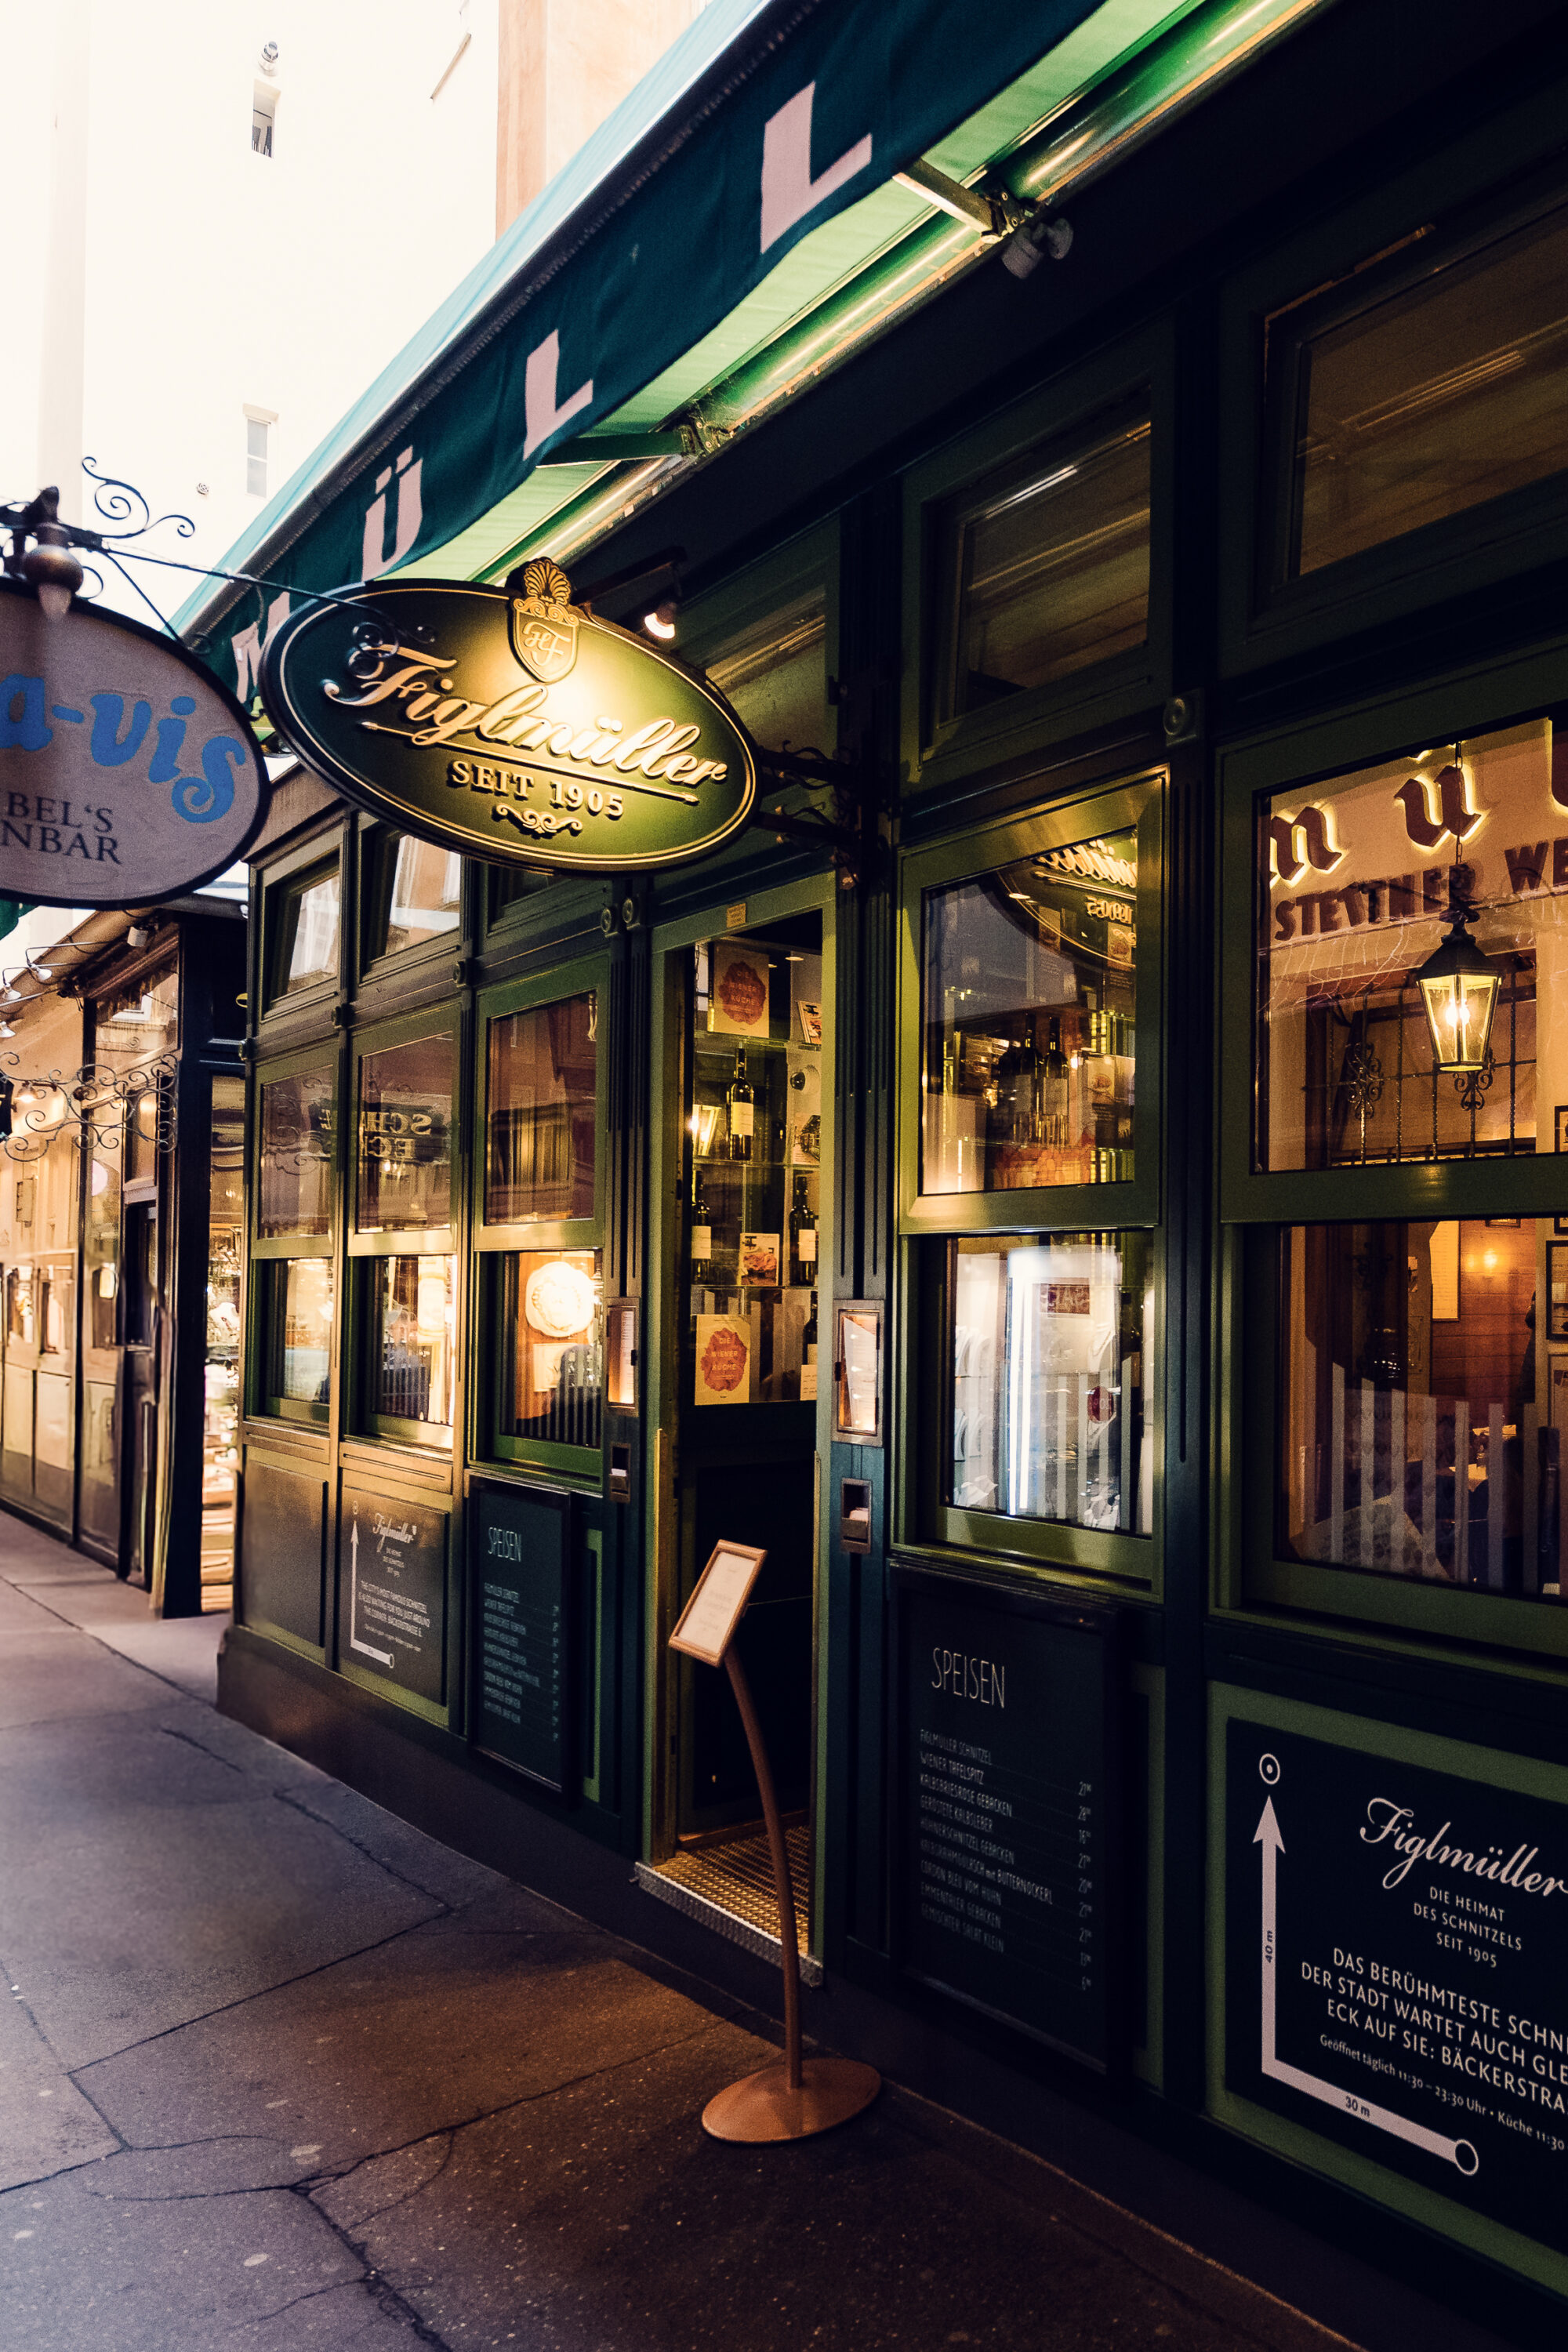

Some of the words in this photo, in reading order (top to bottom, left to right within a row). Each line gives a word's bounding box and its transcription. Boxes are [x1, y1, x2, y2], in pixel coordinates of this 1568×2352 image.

[322, 644, 728, 786] Figlmüller
[449, 760, 534, 800] SEIT
[550, 780, 624, 818] 1905
[0, 818, 122, 866] NBAR
[487, 1526, 522, 1563] SPEISEN
[931, 1646, 1006, 1709] SPEISEN
[1359, 1797, 1568, 1897] Figlmüller
[1414, 1903, 1436, 1921] DES
[1442, 1911, 1522, 1951] SCHNITZELS
[1429, 1886, 1450, 1904] DIE
[1455, 1894, 1505, 1922] HEIMAT
[1436, 1931, 1463, 1951] SEIT
[1468, 1945, 1497, 1969] 1905
[1301, 1961, 1333, 1990] DER
[1338, 1976, 1389, 2013] STADT
[1394, 1998, 1466, 2042] WARTET
[1471, 2027, 1526, 2068] AUCH
[1334, 1947, 1364, 1975] DAS
[1370, 1962, 1501, 2028] BERÜHMTESTE
[1319, 2034, 1361, 2063] Geöffnet
[1363, 2052, 1396, 2078] täglich
[1466, 2096, 1487, 2117] Uhr
[1497, 2109, 1533, 2138] Küche
[1327, 1998, 1359, 2028] ECK
[1364, 2015, 1397, 2042] AUF
[1403, 2027, 1435, 2060] SIE:
[1442, 2046, 1568, 2114] BÄCKERSTRA
[1345, 2095, 1359, 2112] 30
